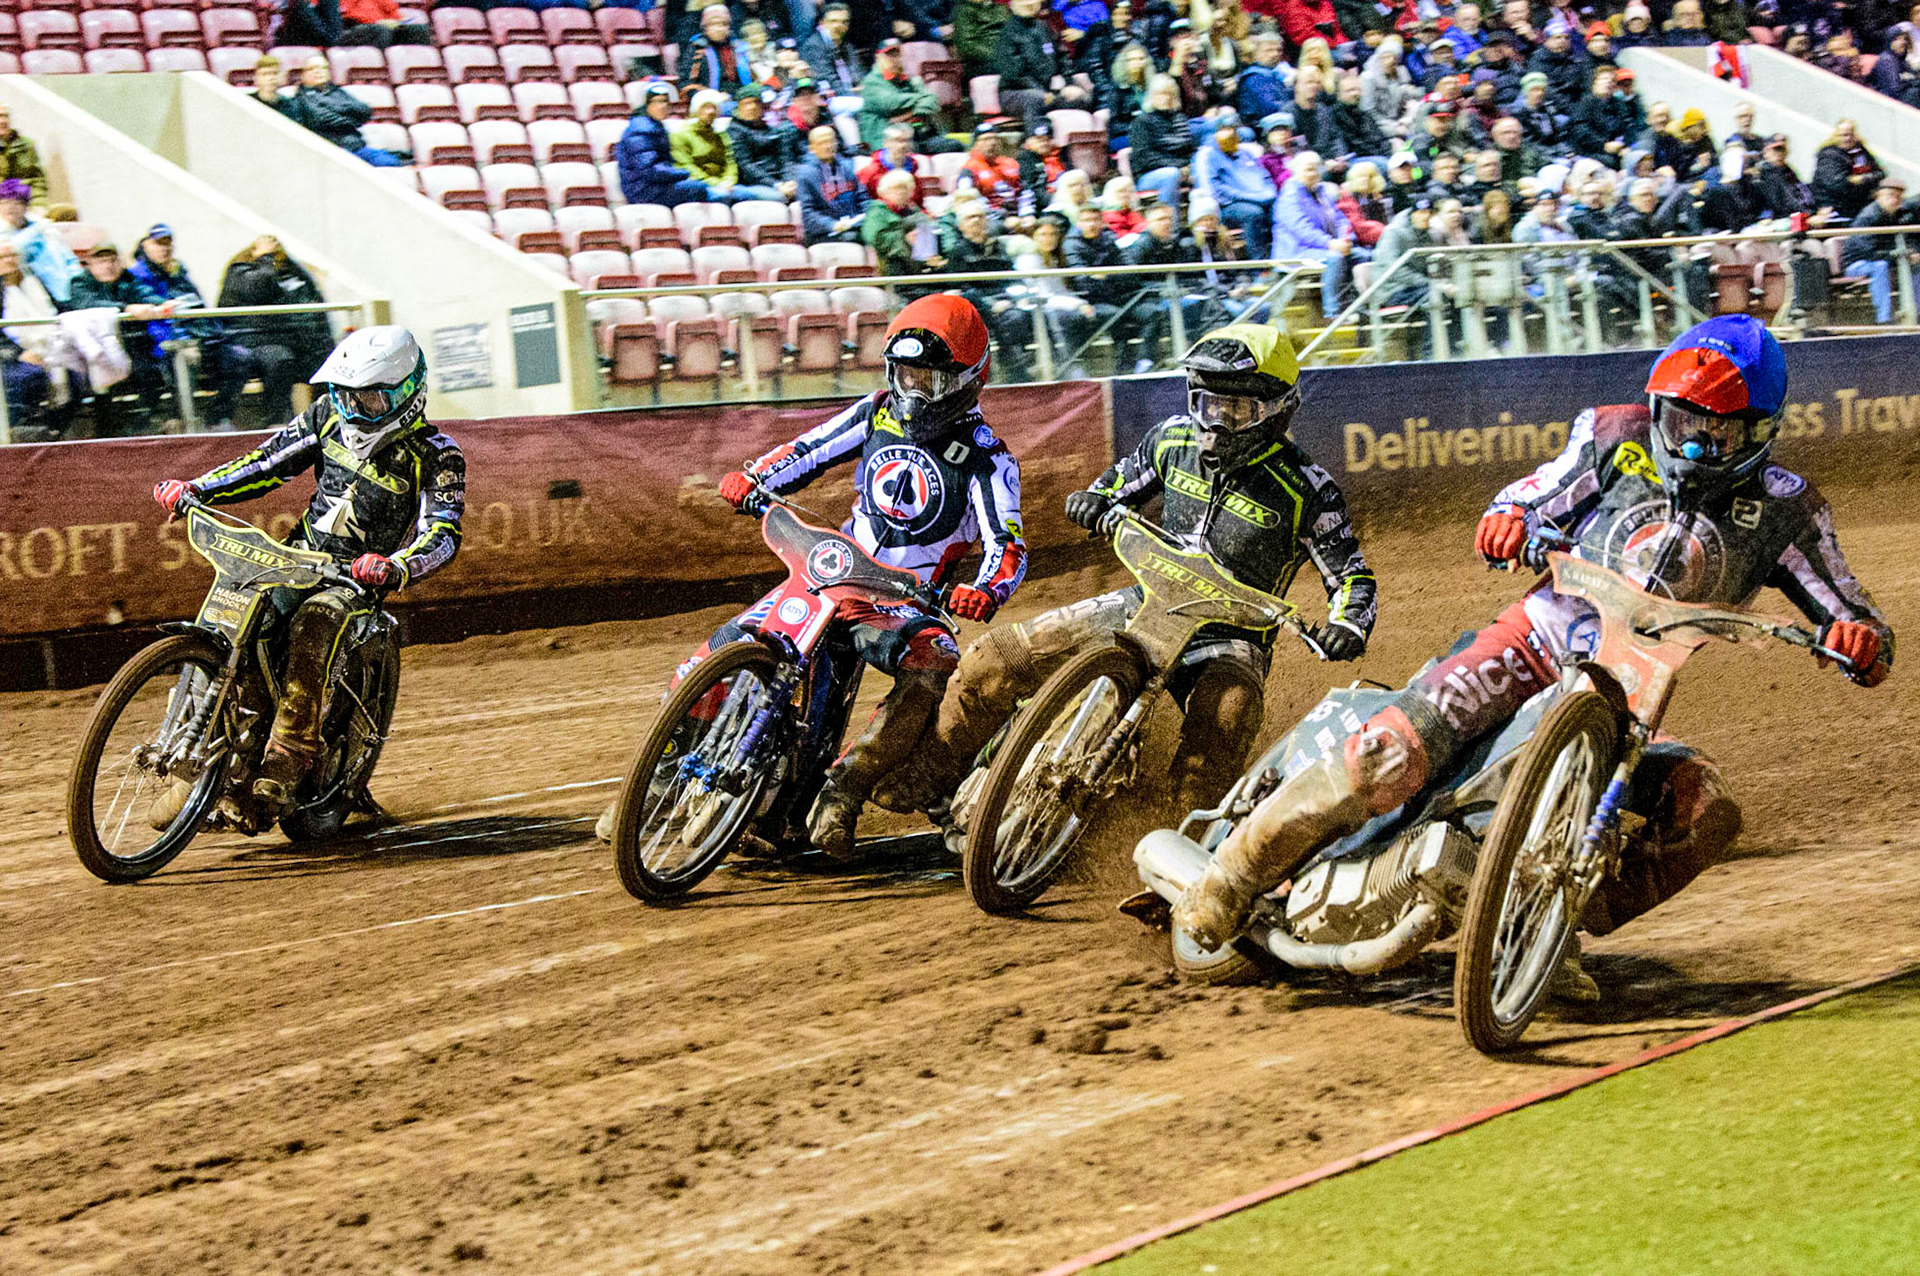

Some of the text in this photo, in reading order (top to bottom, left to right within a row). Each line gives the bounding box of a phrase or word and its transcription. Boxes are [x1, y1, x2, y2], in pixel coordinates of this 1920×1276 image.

[870, 449, 902, 471] BELLE
[924, 467, 940, 496] ACES
[1220, 493, 1271, 524] MIX
[217, 538, 291, 569] TRU MIX
[1151, 558, 1194, 583] TRU
[211, 594, 246, 612] SHOCKS
[214, 586, 251, 606] HAGON
